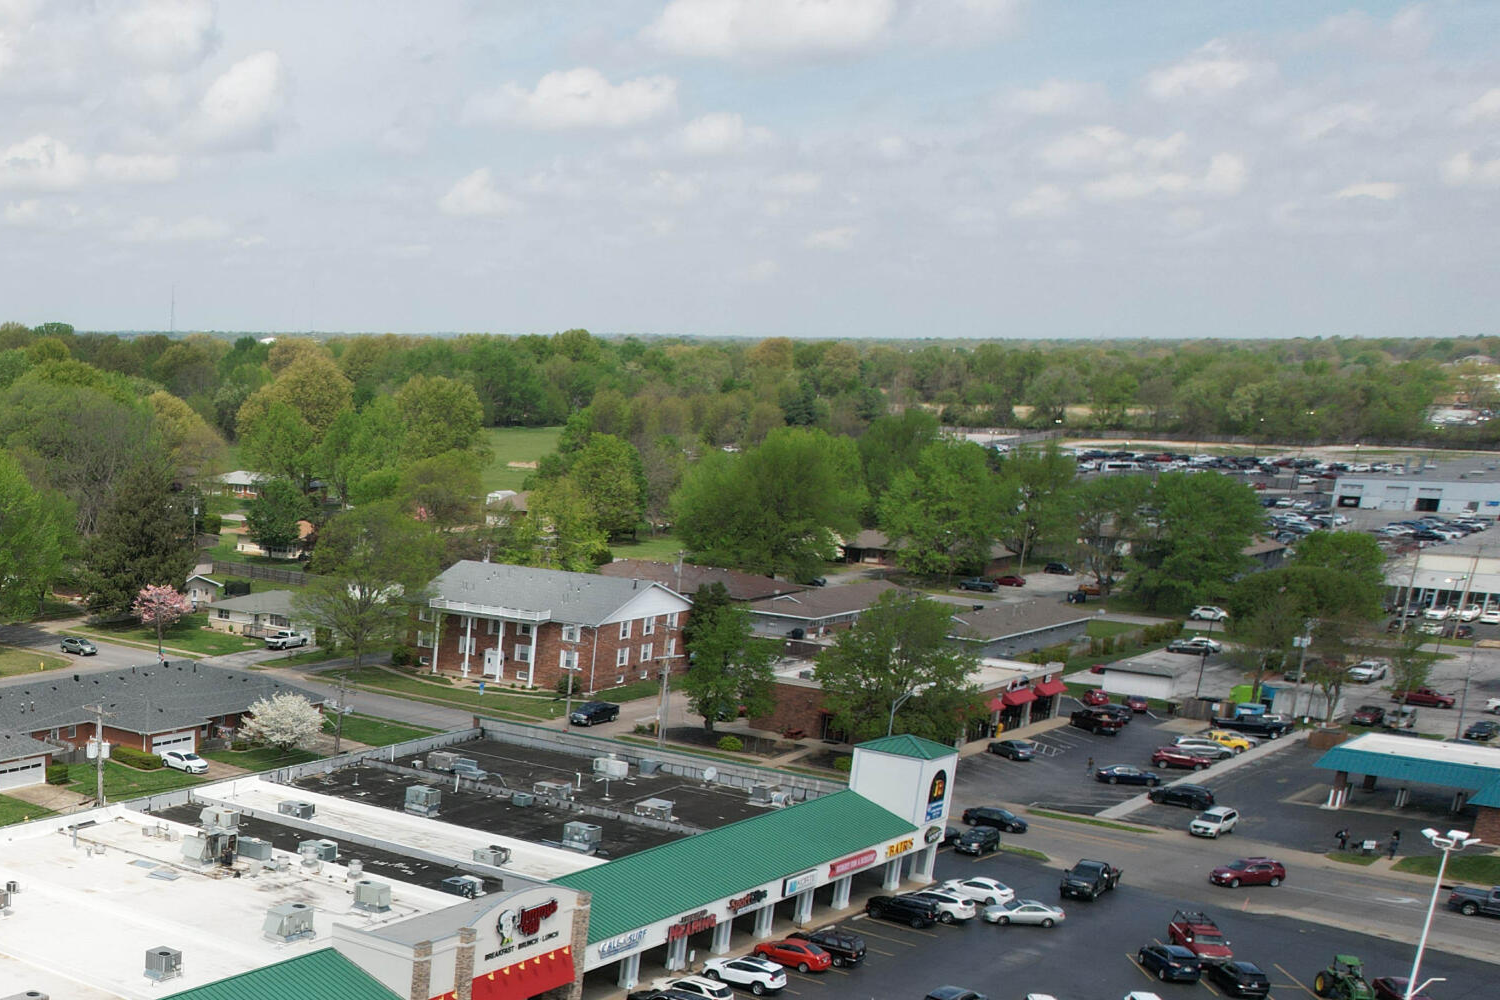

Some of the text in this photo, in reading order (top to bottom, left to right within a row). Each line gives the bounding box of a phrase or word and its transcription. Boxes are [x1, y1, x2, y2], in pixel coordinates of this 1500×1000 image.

[667, 914, 717, 942] HEARING
[484, 931, 559, 961] BREAKFAST BRUNCH LUNCH
